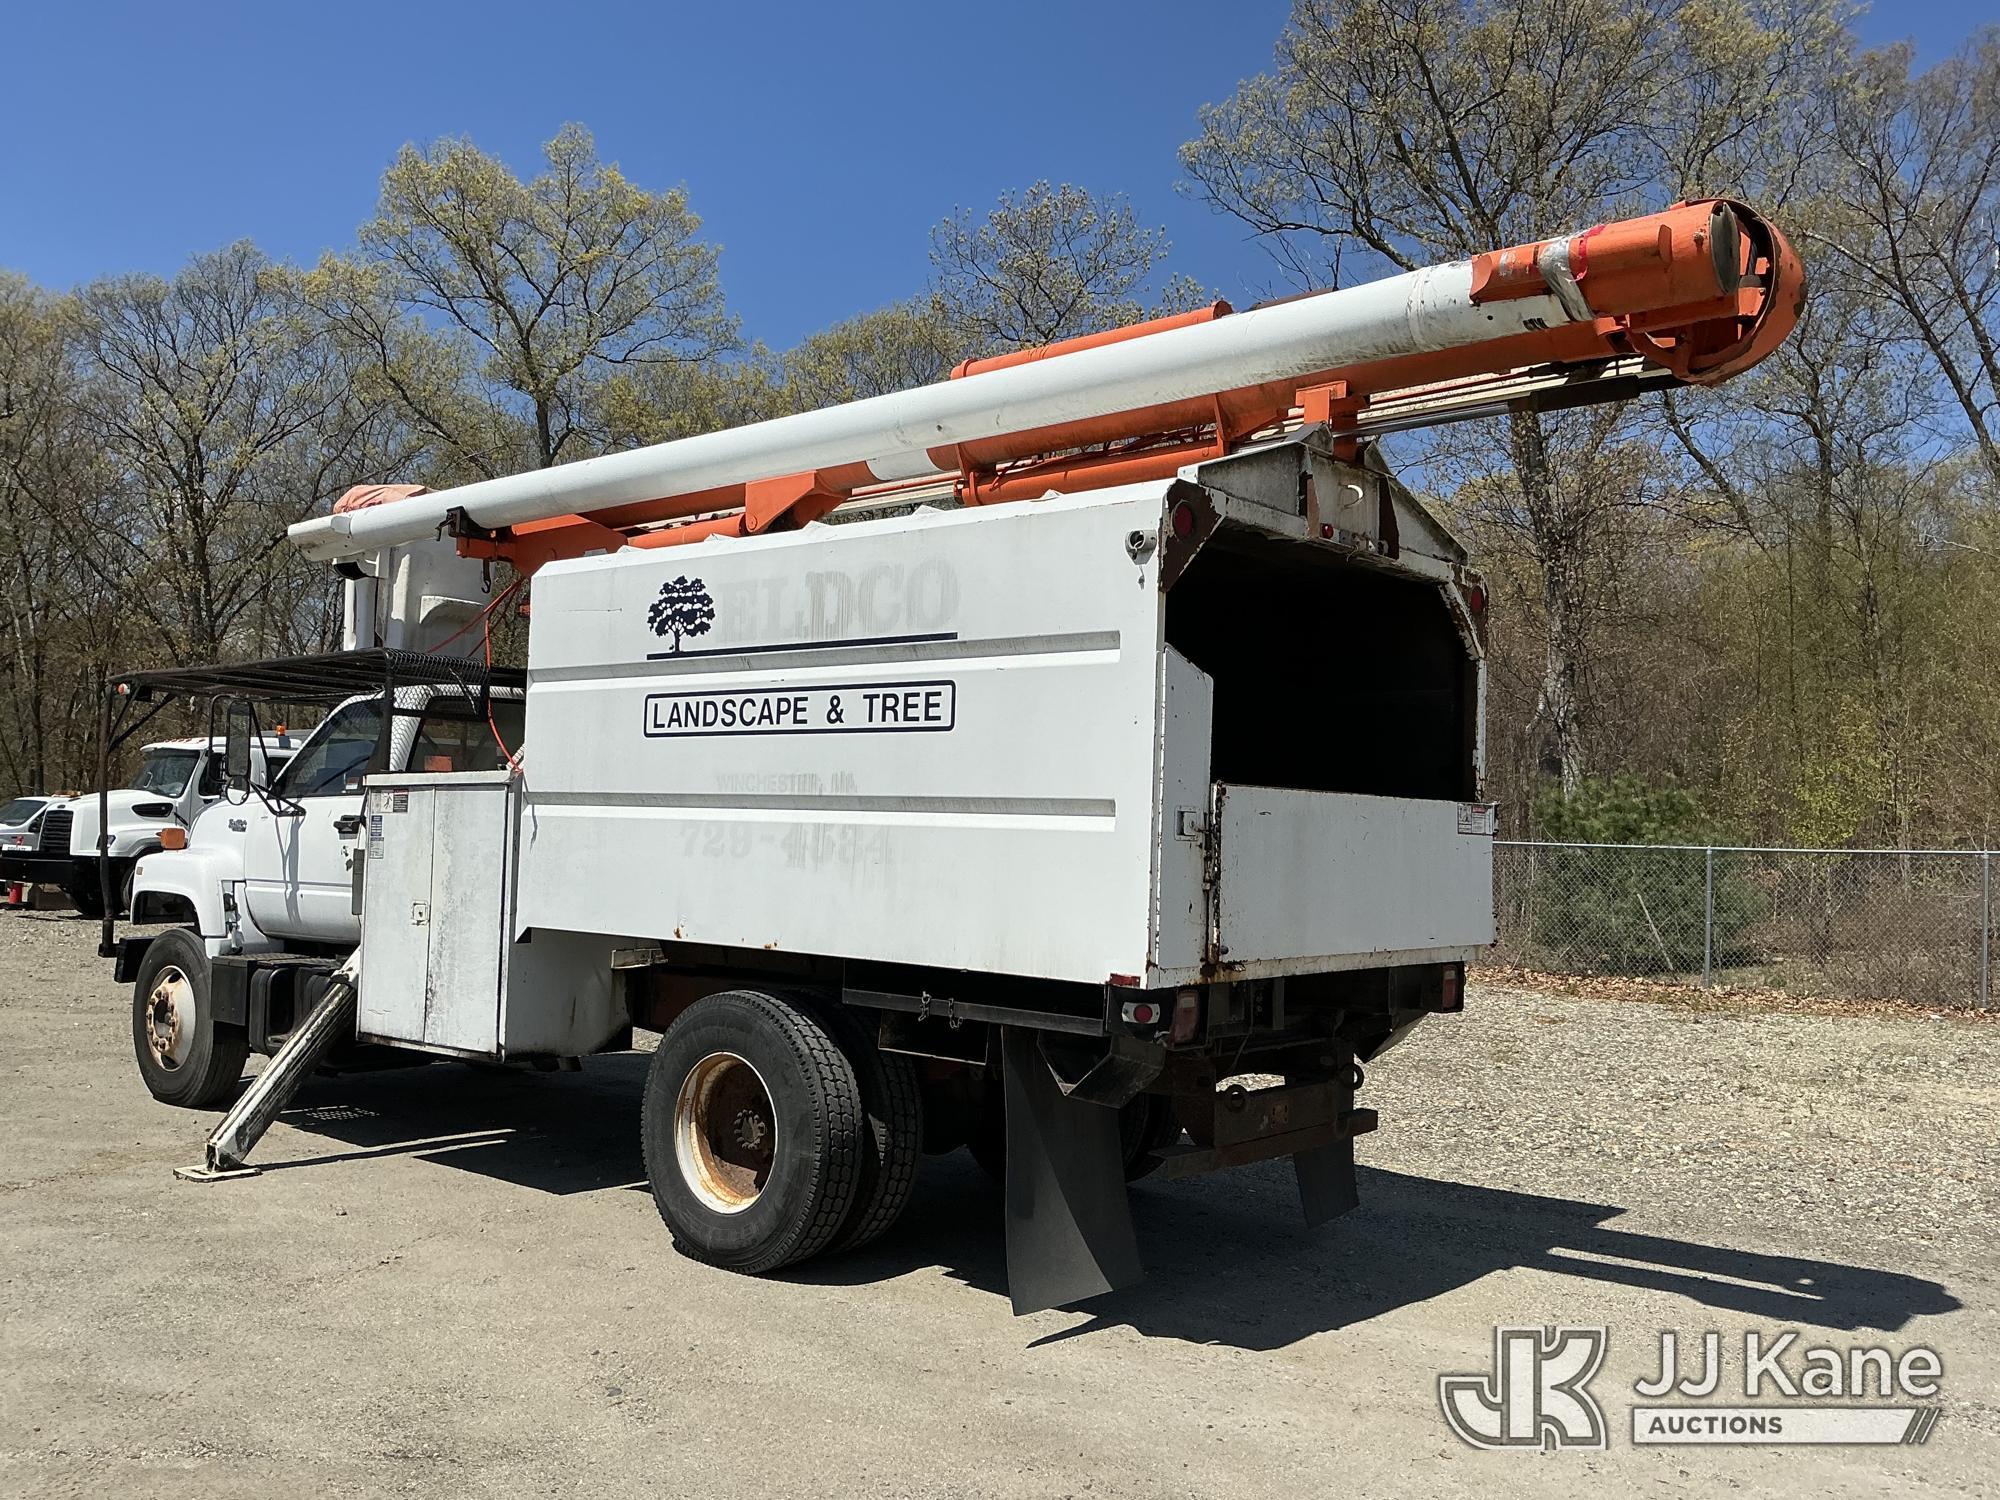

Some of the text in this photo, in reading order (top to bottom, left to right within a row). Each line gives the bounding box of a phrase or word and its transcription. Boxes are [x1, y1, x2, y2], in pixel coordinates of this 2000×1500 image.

[653, 691, 942, 729] LANDSCAPE & TREE
